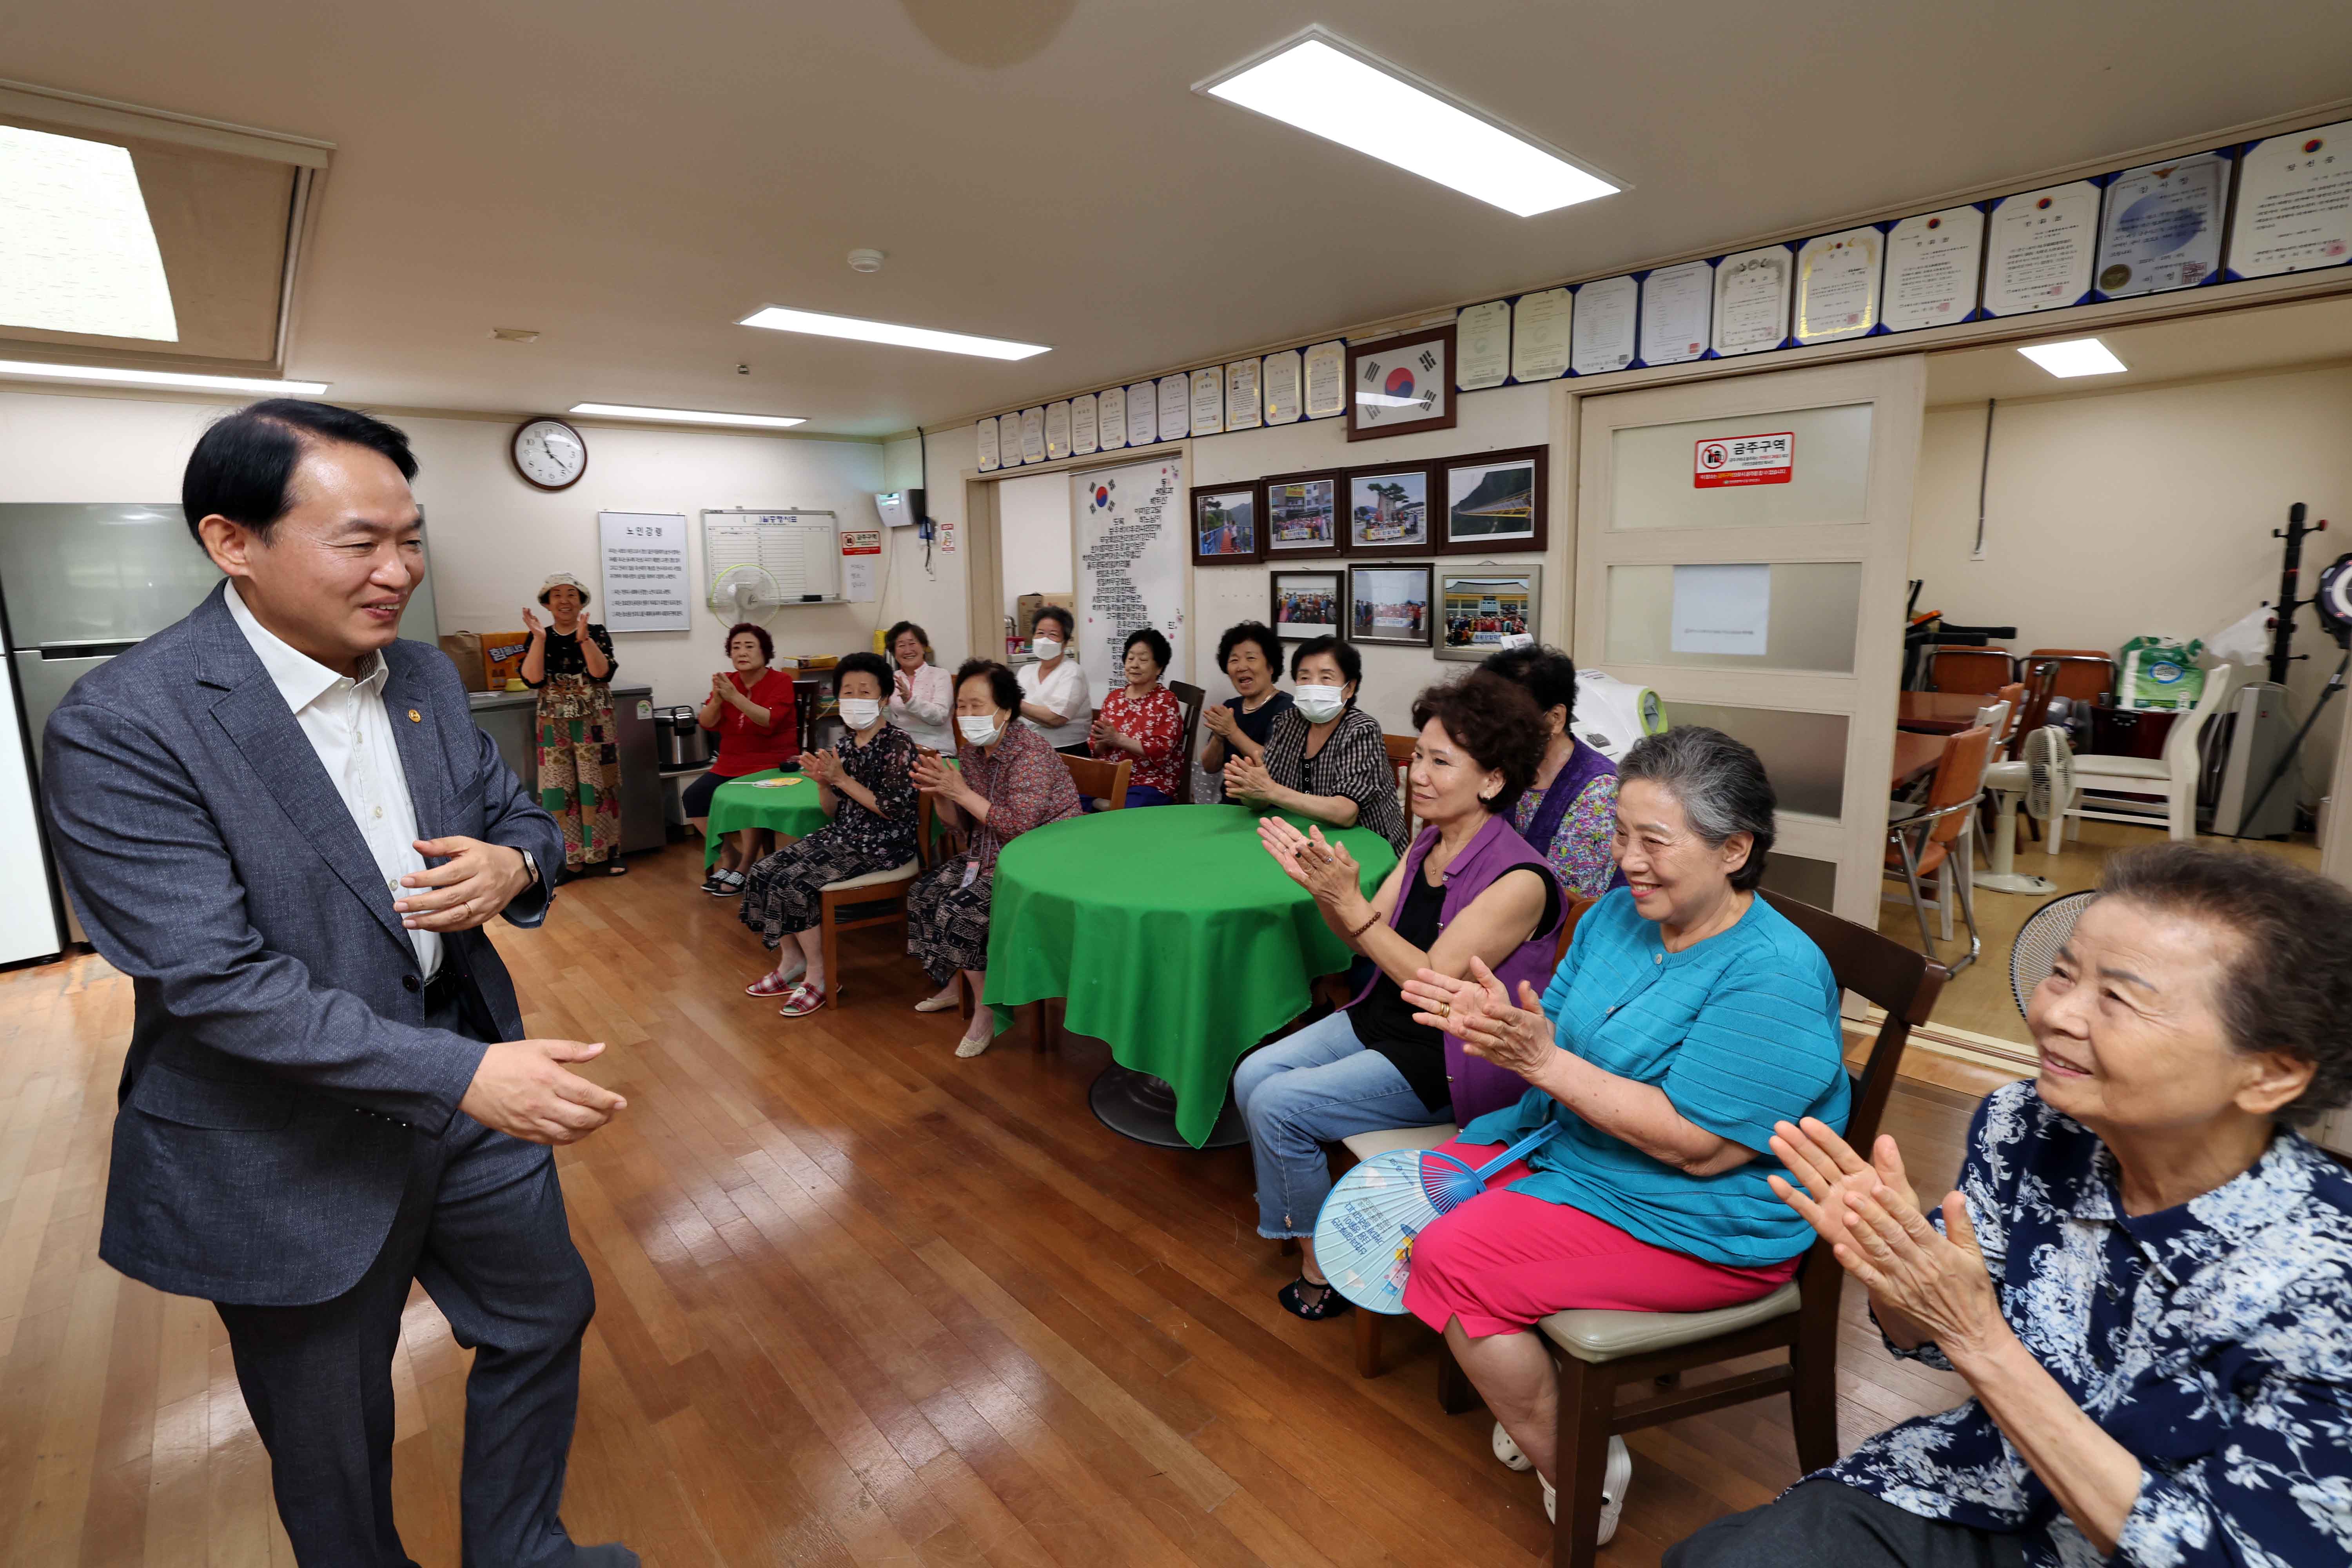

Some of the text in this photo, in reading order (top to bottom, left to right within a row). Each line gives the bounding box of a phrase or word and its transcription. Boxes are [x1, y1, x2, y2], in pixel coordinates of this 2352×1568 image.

[1733, 439, 1785, 455] 금주구역
[626, 526, 662, 537] 노인강령
[1331, 1218, 1367, 1256] 신협과 함께라면
[1343, 1216, 1370, 1245] 금융 생활이
[1345, 1202, 1384, 1246] 가볍게 올라갑니다
